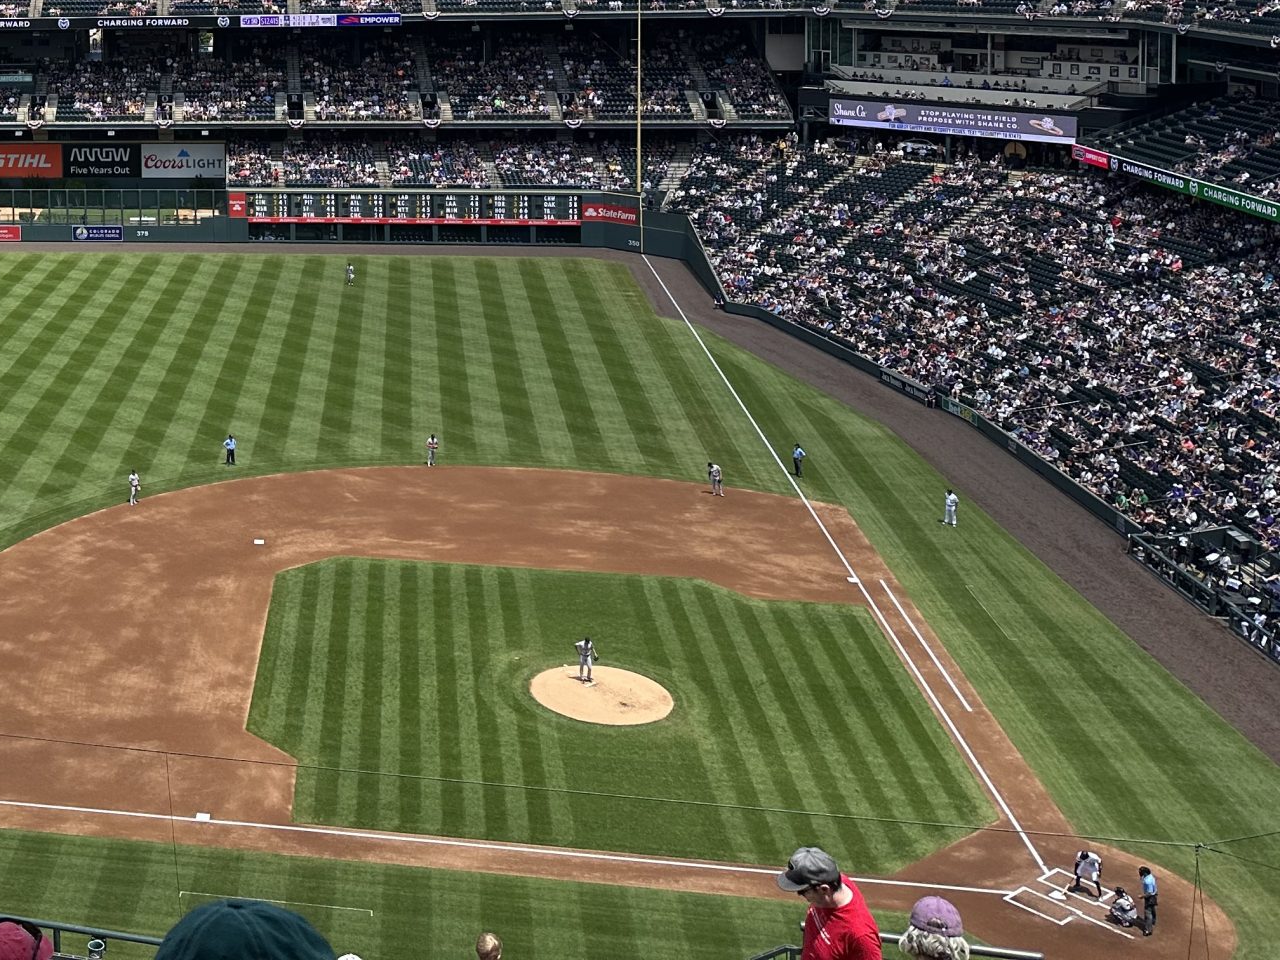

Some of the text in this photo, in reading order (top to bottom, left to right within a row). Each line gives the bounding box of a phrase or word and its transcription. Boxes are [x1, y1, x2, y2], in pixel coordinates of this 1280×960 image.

[97, 18, 189, 27] CHARGING FORWARD
[359, 16, 399, 24] EMPOWER
[834, 103, 856, 117] Shane
[942, 111, 975, 119] PLAYING
[918, 116, 952, 124] PROPOSE
[70, 147, 131, 162] ARROW
[144, 153, 223, 169] Coors LIGHT
[70, 166, 130, 174] Five Years Out
[1122, 162, 1184, 189] CHARGING FORWARD
[1203, 187, 1277, 217] CHARGING FORWARD
[627, 239, 640, 247] 350
